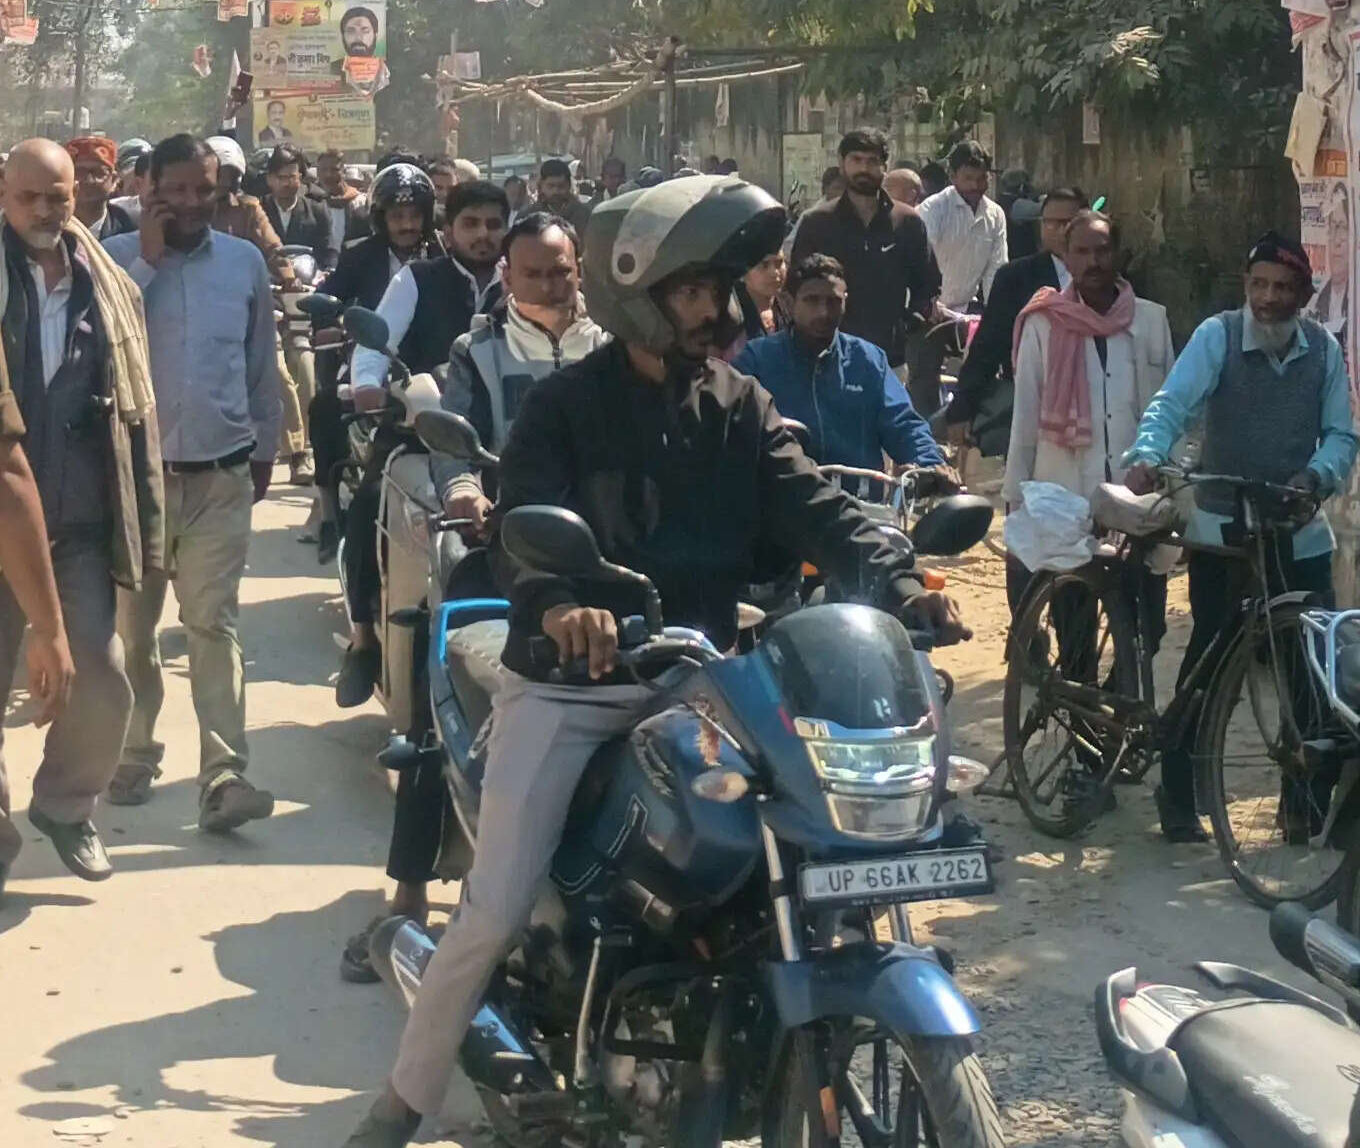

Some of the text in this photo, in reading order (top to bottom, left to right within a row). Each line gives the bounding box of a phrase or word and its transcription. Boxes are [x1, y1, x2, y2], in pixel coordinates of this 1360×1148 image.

[828, 858, 983, 892] UP 66AK 2262
